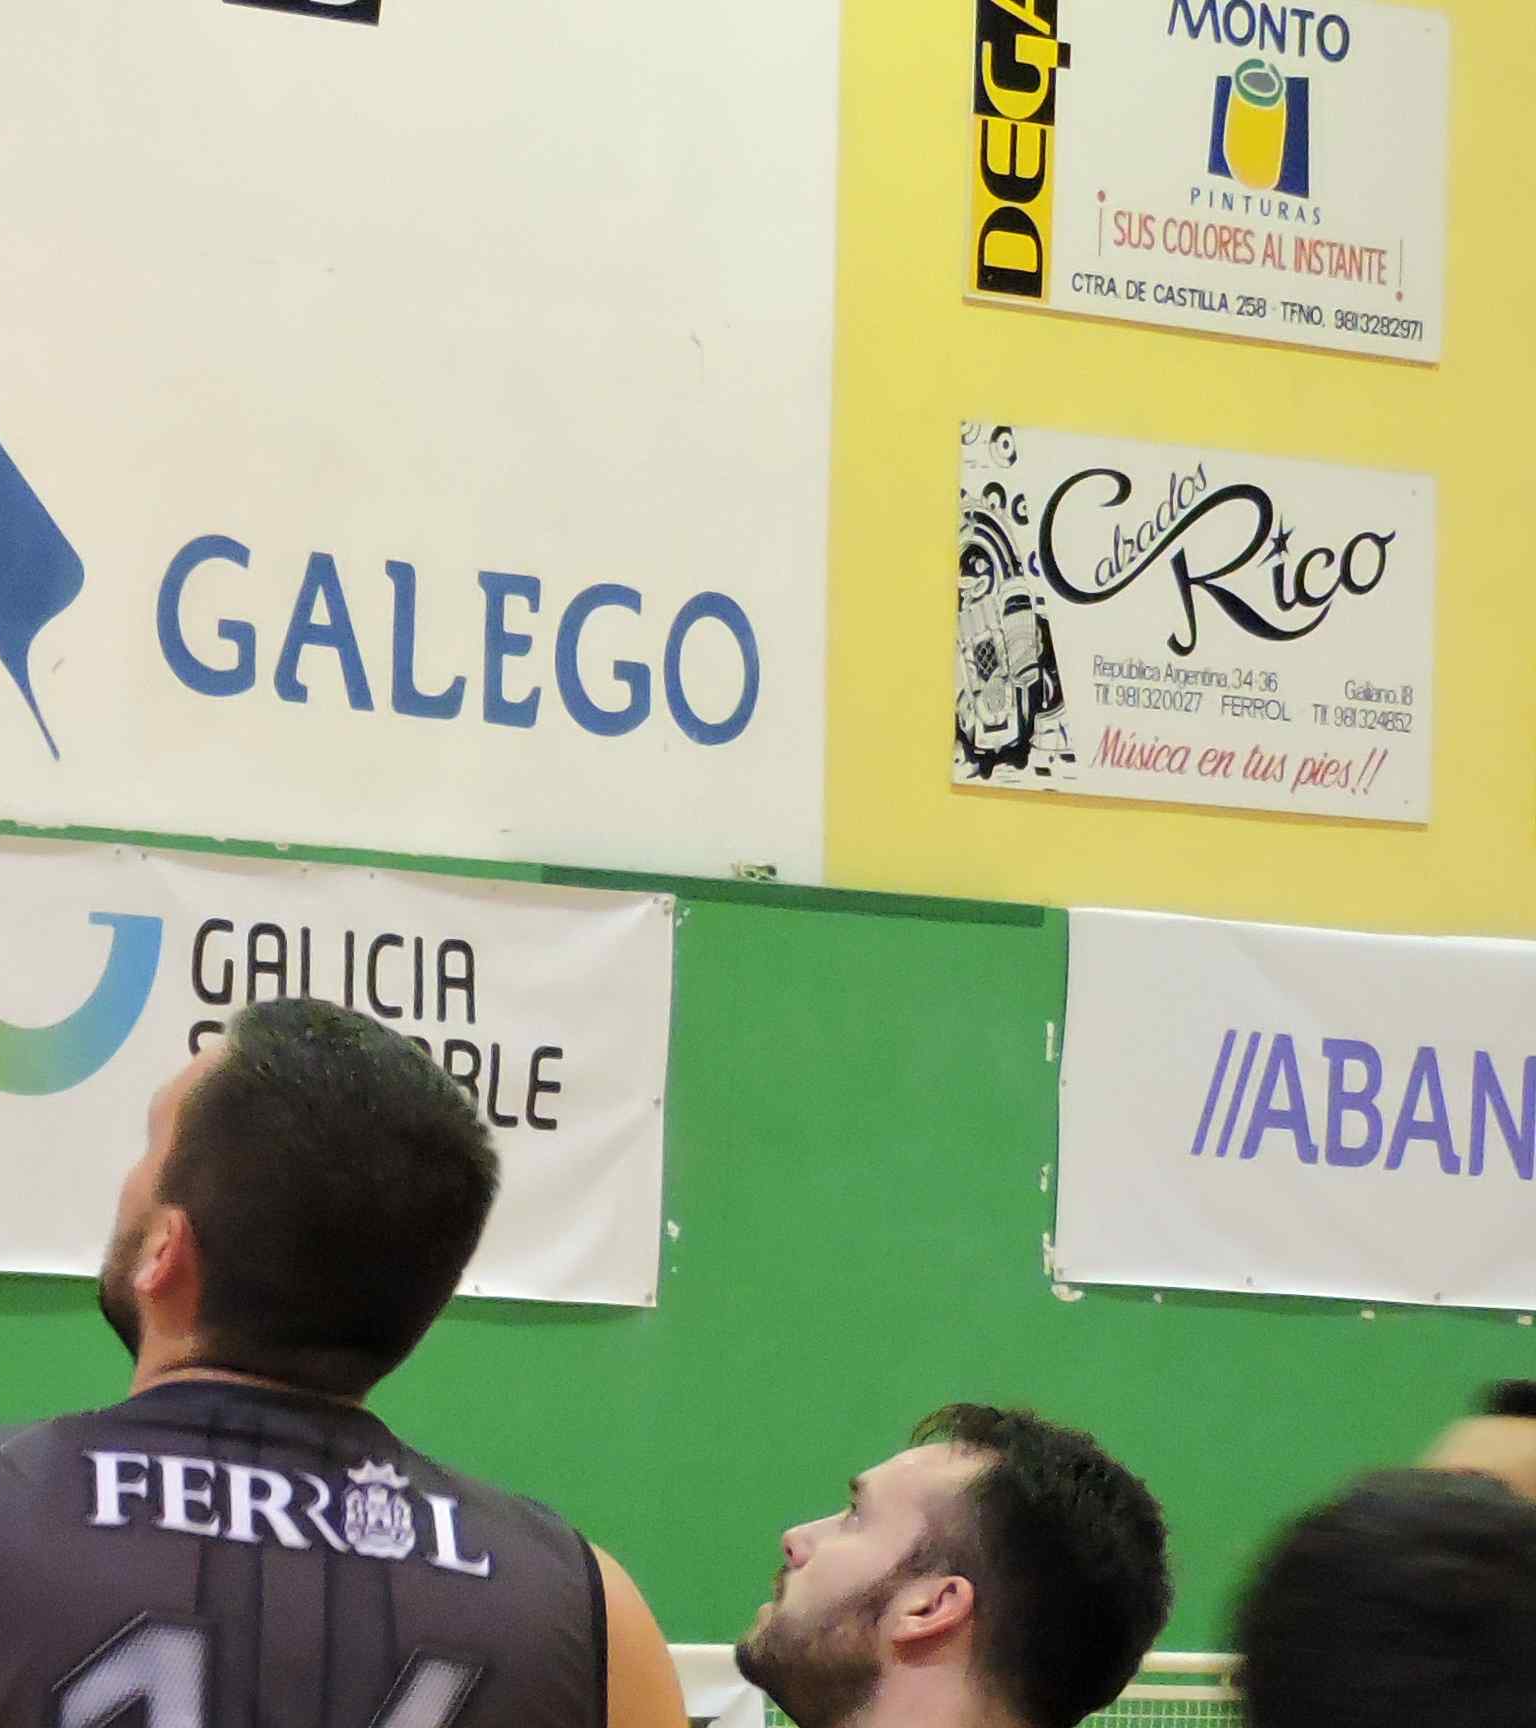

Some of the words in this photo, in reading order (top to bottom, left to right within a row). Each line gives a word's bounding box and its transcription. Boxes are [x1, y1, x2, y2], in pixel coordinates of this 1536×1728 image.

[1167, 0, 1350, 62] MONTO
[1191, 187, 1321, 225] PINTURAS
[1163, 217, 1255, 265] COLORES
[1262, 233, 1286, 271] AL
[1126, 279, 1147, 302] DE
[1236, 295, 1267, 319] 258
[1168, 484, 1396, 656] Rico
[156, 533, 760, 746] GALEGO
[1220, 695, 1291, 722] FERROL
[1198, 747, 1237, 779] en
[1243, 744, 1287, 783] tus
[191, 917, 476, 1024] GALICIA
